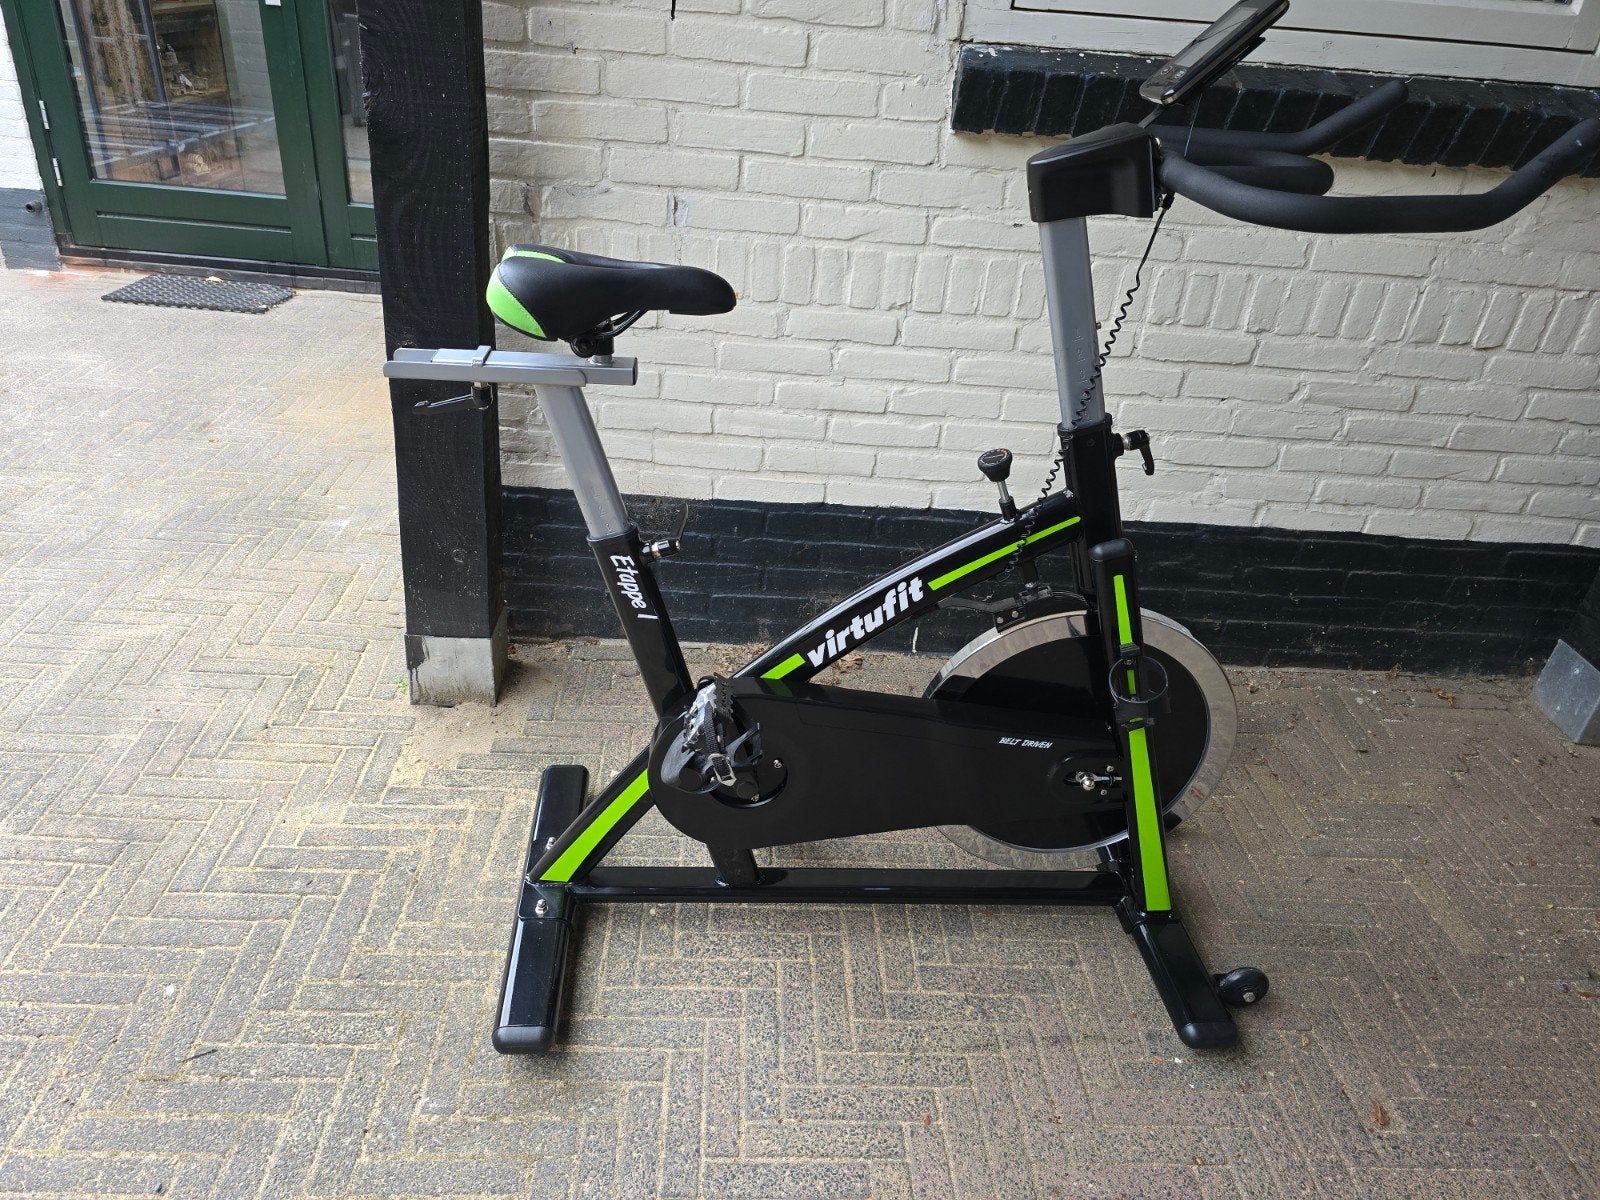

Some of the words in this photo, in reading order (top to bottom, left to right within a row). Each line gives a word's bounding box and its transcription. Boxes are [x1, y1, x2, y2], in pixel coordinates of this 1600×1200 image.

[609, 555, 647, 609] Etappe
[806, 576, 924, 668] virtufit
[998, 736, 1022, 746] BELT
[1021, 739, 1053, 749] DRIVEN
